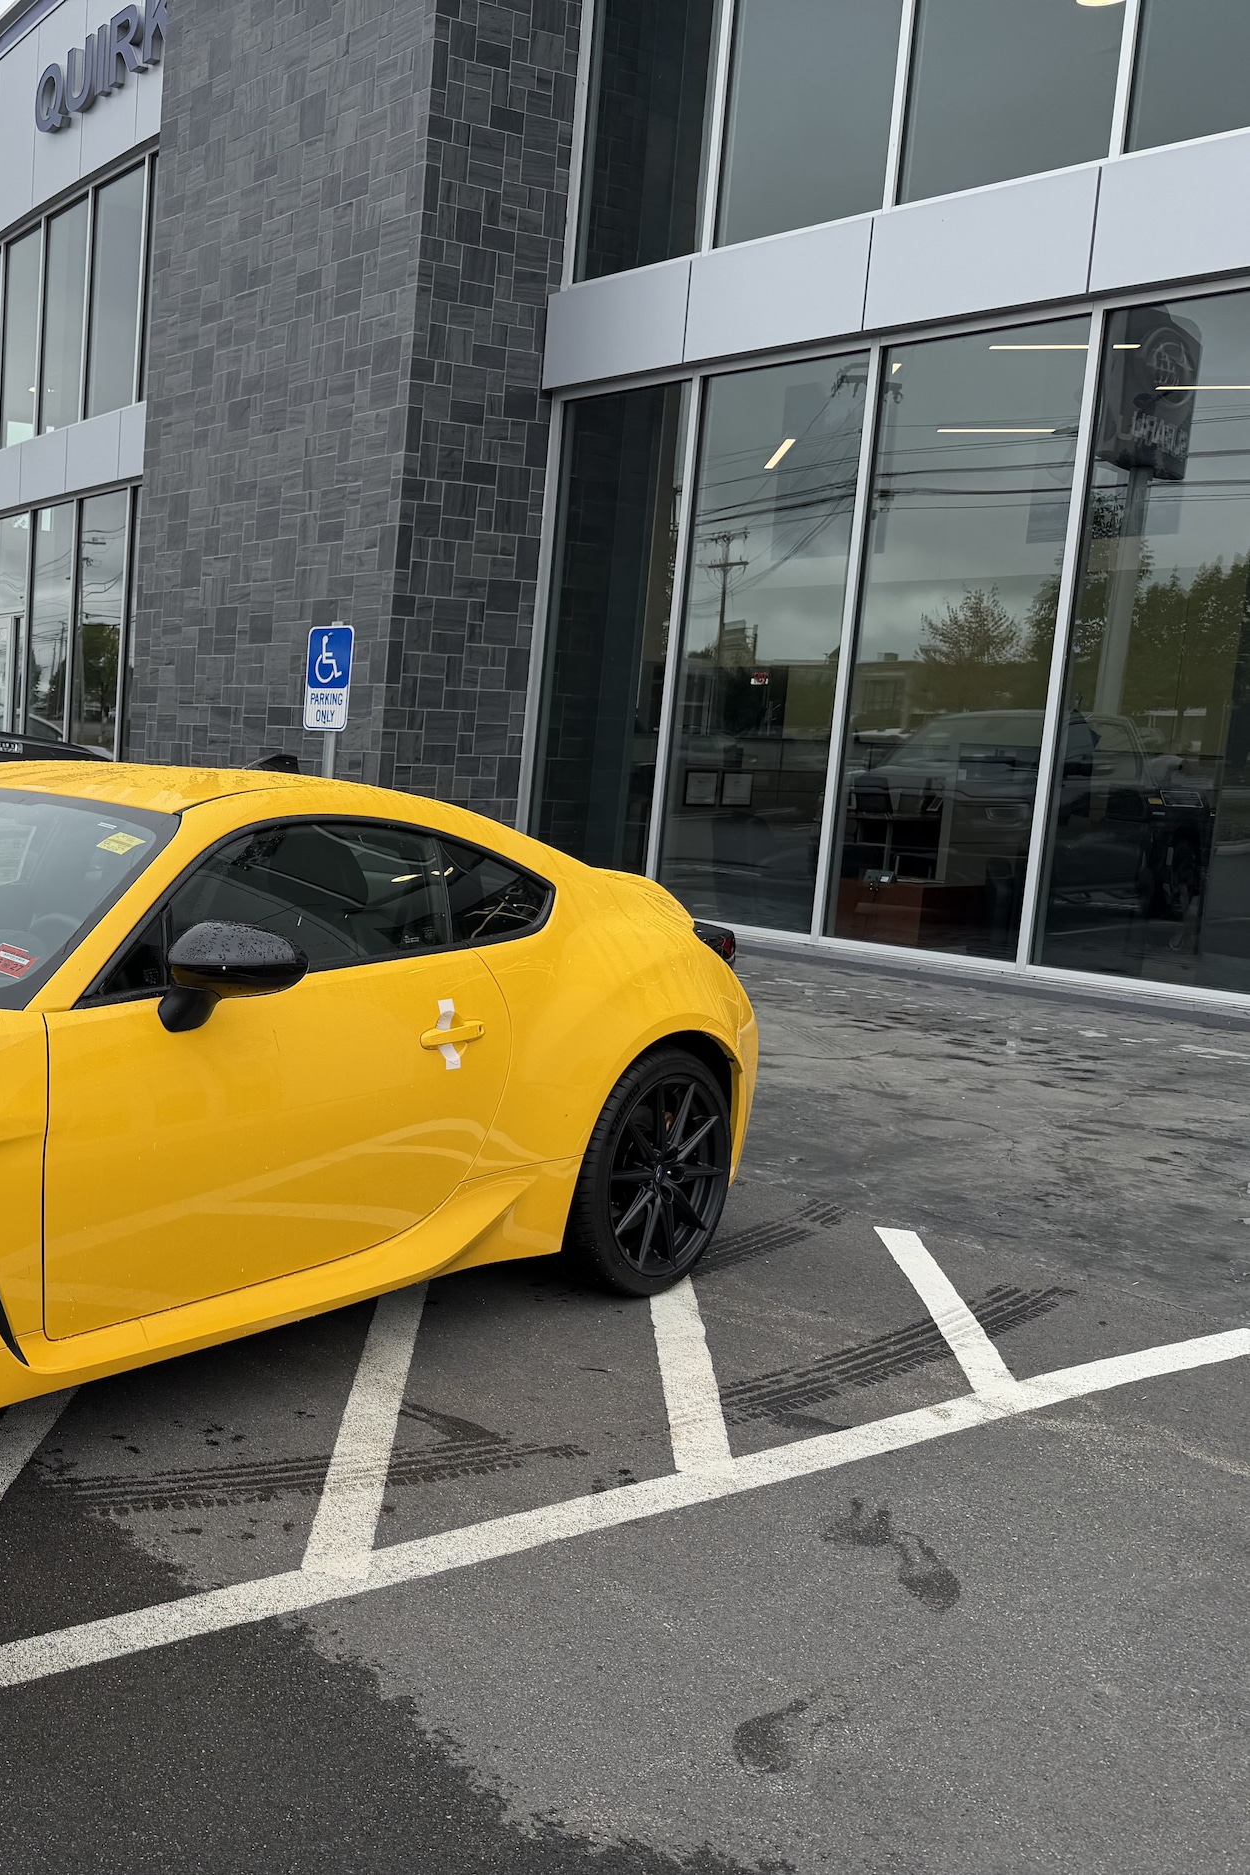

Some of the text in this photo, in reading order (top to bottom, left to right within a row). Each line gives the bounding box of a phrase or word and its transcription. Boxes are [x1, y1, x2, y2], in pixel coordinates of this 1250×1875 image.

[35, 0, 167, 133] QUIRK
[310, 692, 343, 706] PARKING
[315, 709, 335, 724] ONLY
[10, 963, 24, 972] 27
